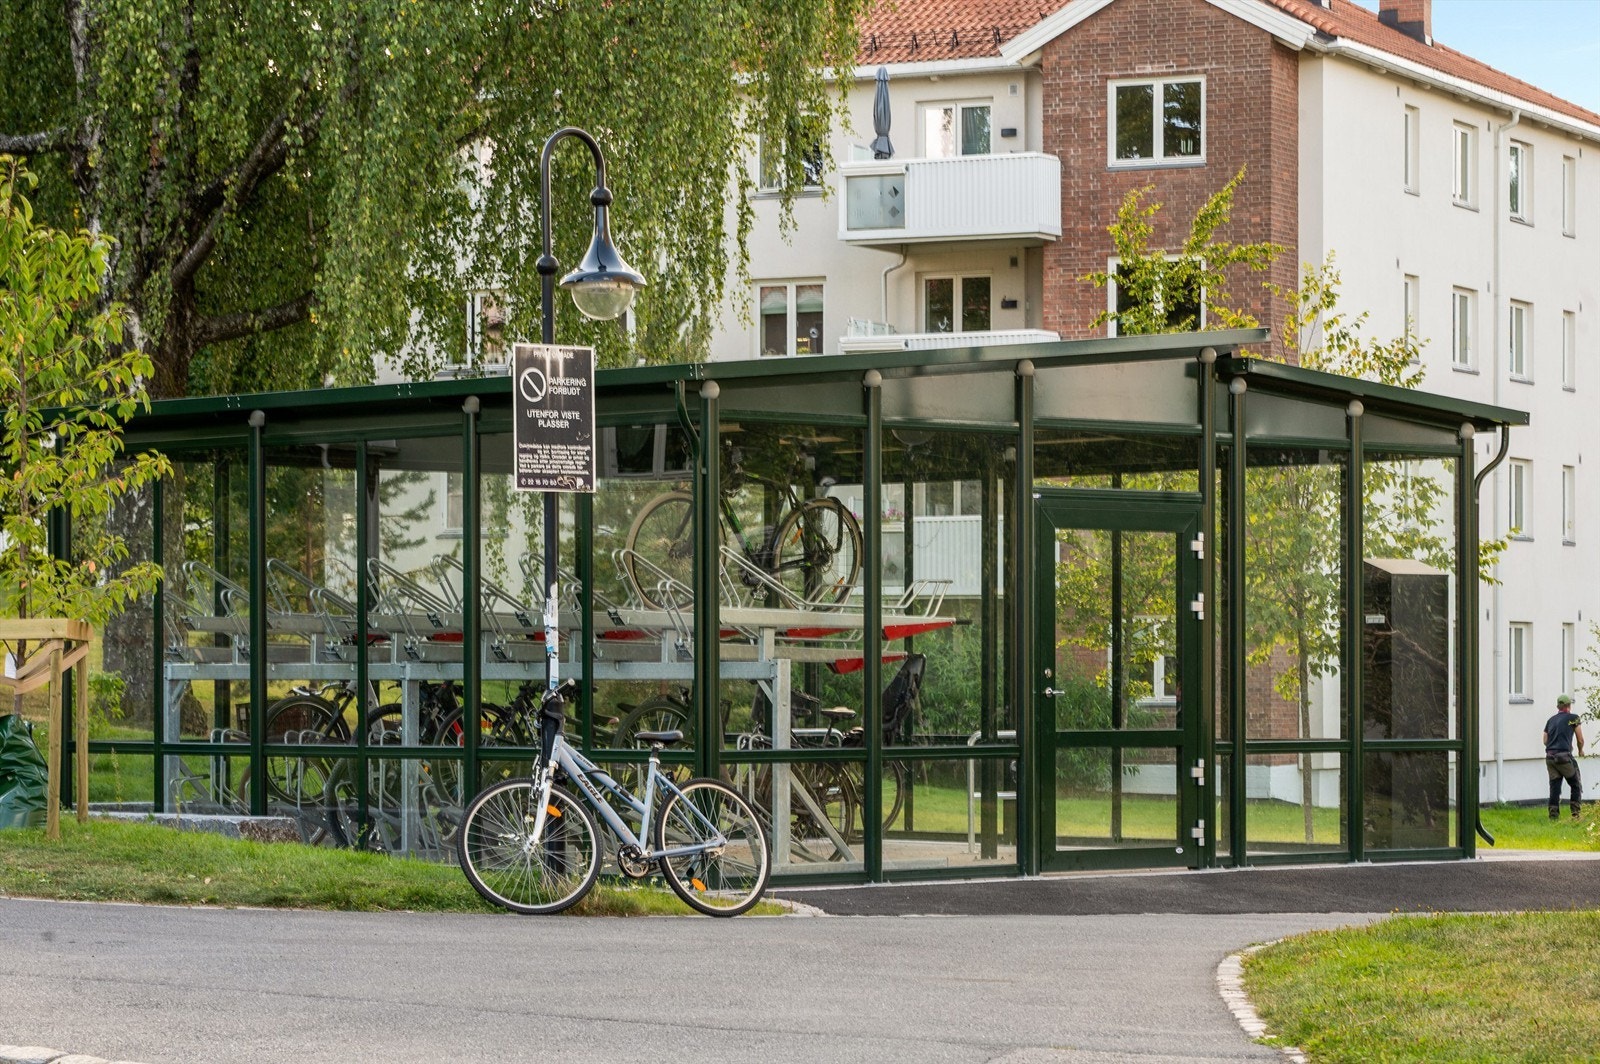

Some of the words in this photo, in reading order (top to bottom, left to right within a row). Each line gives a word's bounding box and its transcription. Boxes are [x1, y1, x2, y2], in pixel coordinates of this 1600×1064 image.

[549, 376, 587, 387] PARKERING
[549, 386, 581, 396] FORBUDT
[527, 408, 559, 419] UTENFOR
[538, 419, 570, 429] PLASSER
[577, 773, 603, 804] EAGLE
